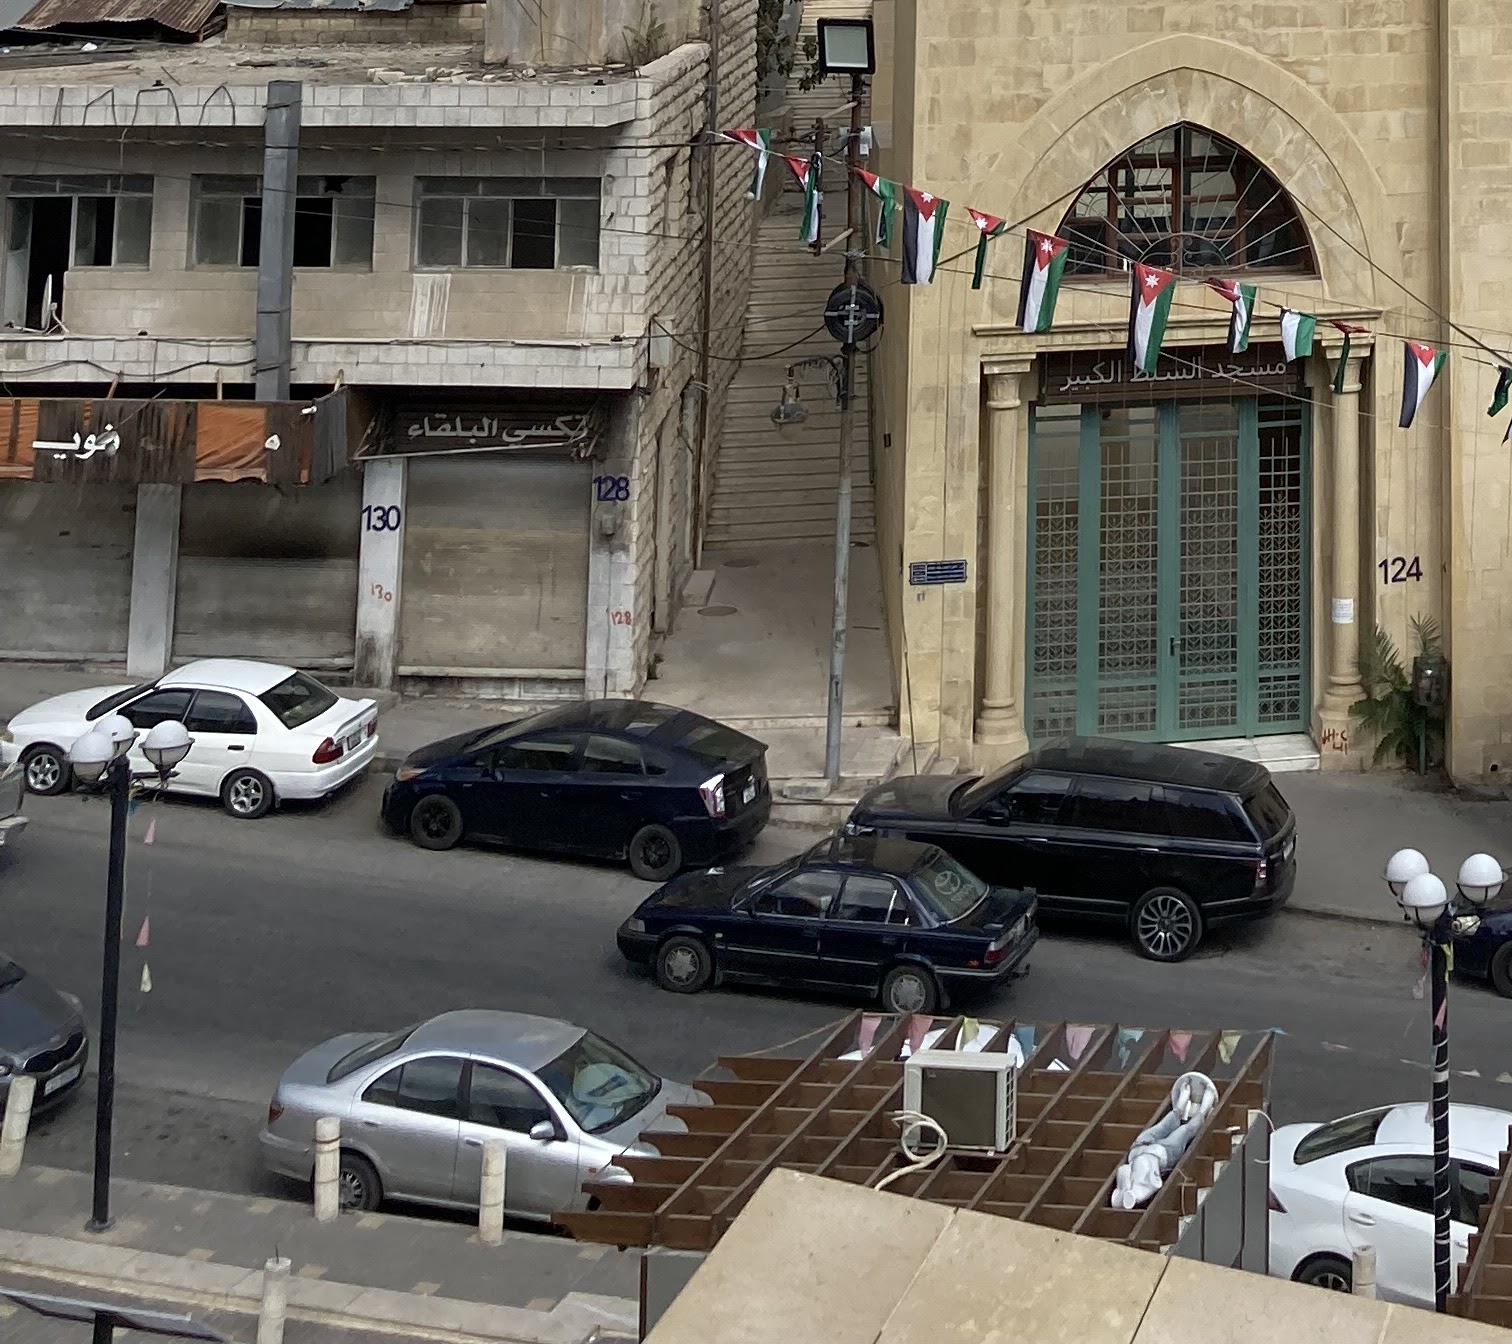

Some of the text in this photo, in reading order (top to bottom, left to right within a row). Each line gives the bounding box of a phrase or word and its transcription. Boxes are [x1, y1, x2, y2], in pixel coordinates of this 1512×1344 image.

[1059, 359, 1122, 392] الكبير
[1211, 360, 1287, 383] مسجد
[407, 413, 498, 444] البلقاء
[593, 476, 630, 502] 128
[361, 505, 401, 532] 130
[1378, 556, 1423, 585] 124
[371, 582, 393, 602] 130
[610, 611, 632, 626] 128
